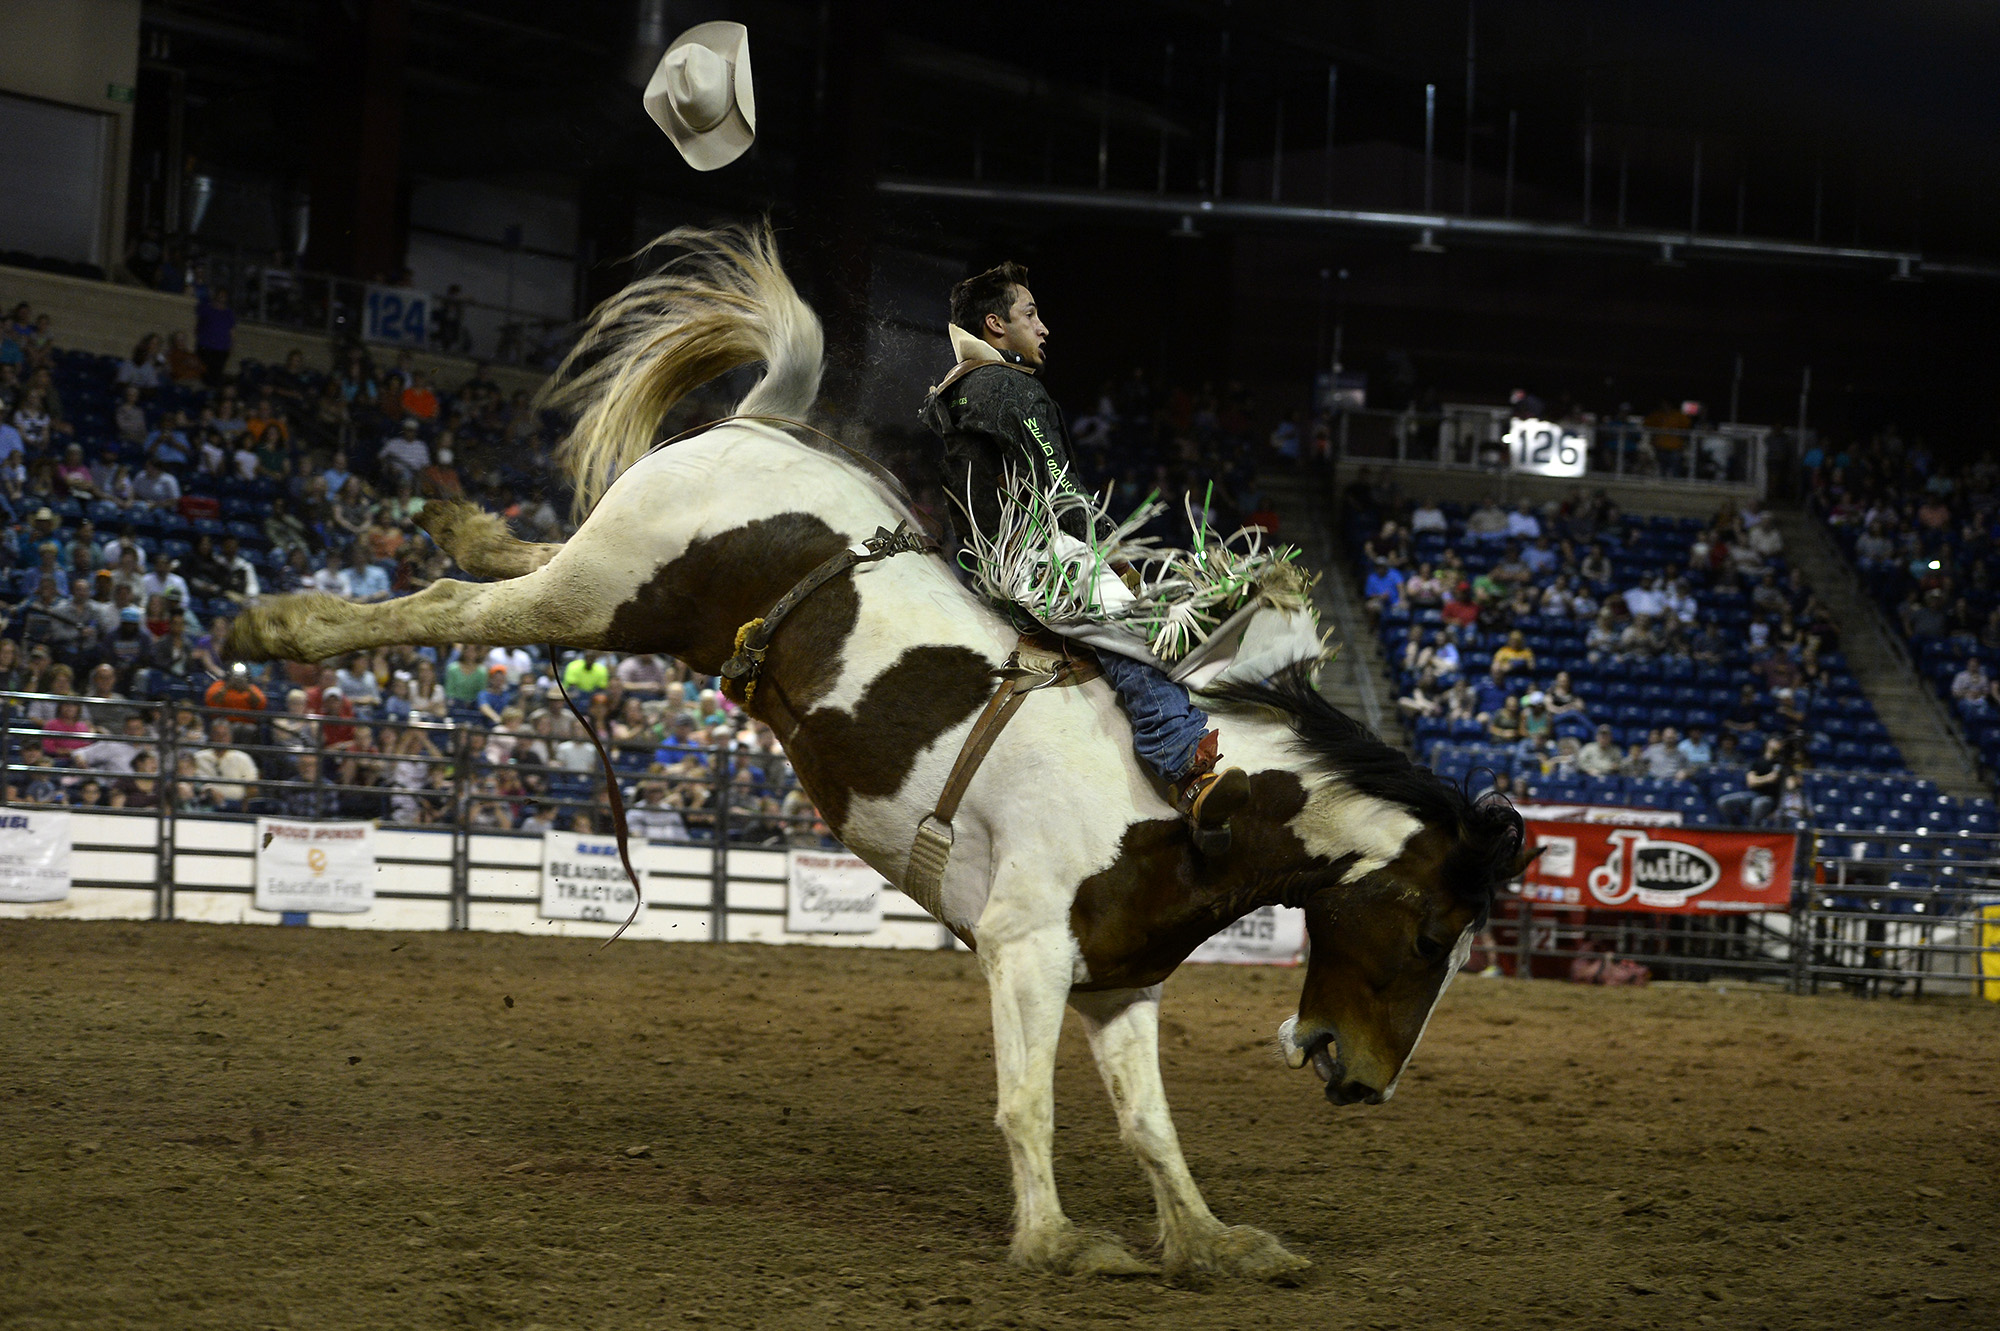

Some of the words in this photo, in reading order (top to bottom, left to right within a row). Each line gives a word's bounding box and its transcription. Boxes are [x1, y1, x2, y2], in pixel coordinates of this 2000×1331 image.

[368, 293, 426, 343] 124
[1023, 417, 1054, 457] WELD
[1519, 429, 1579, 466] 126
[1588, 829, 1709, 905] Justin
[558, 884, 634, 903] TRACTOR
